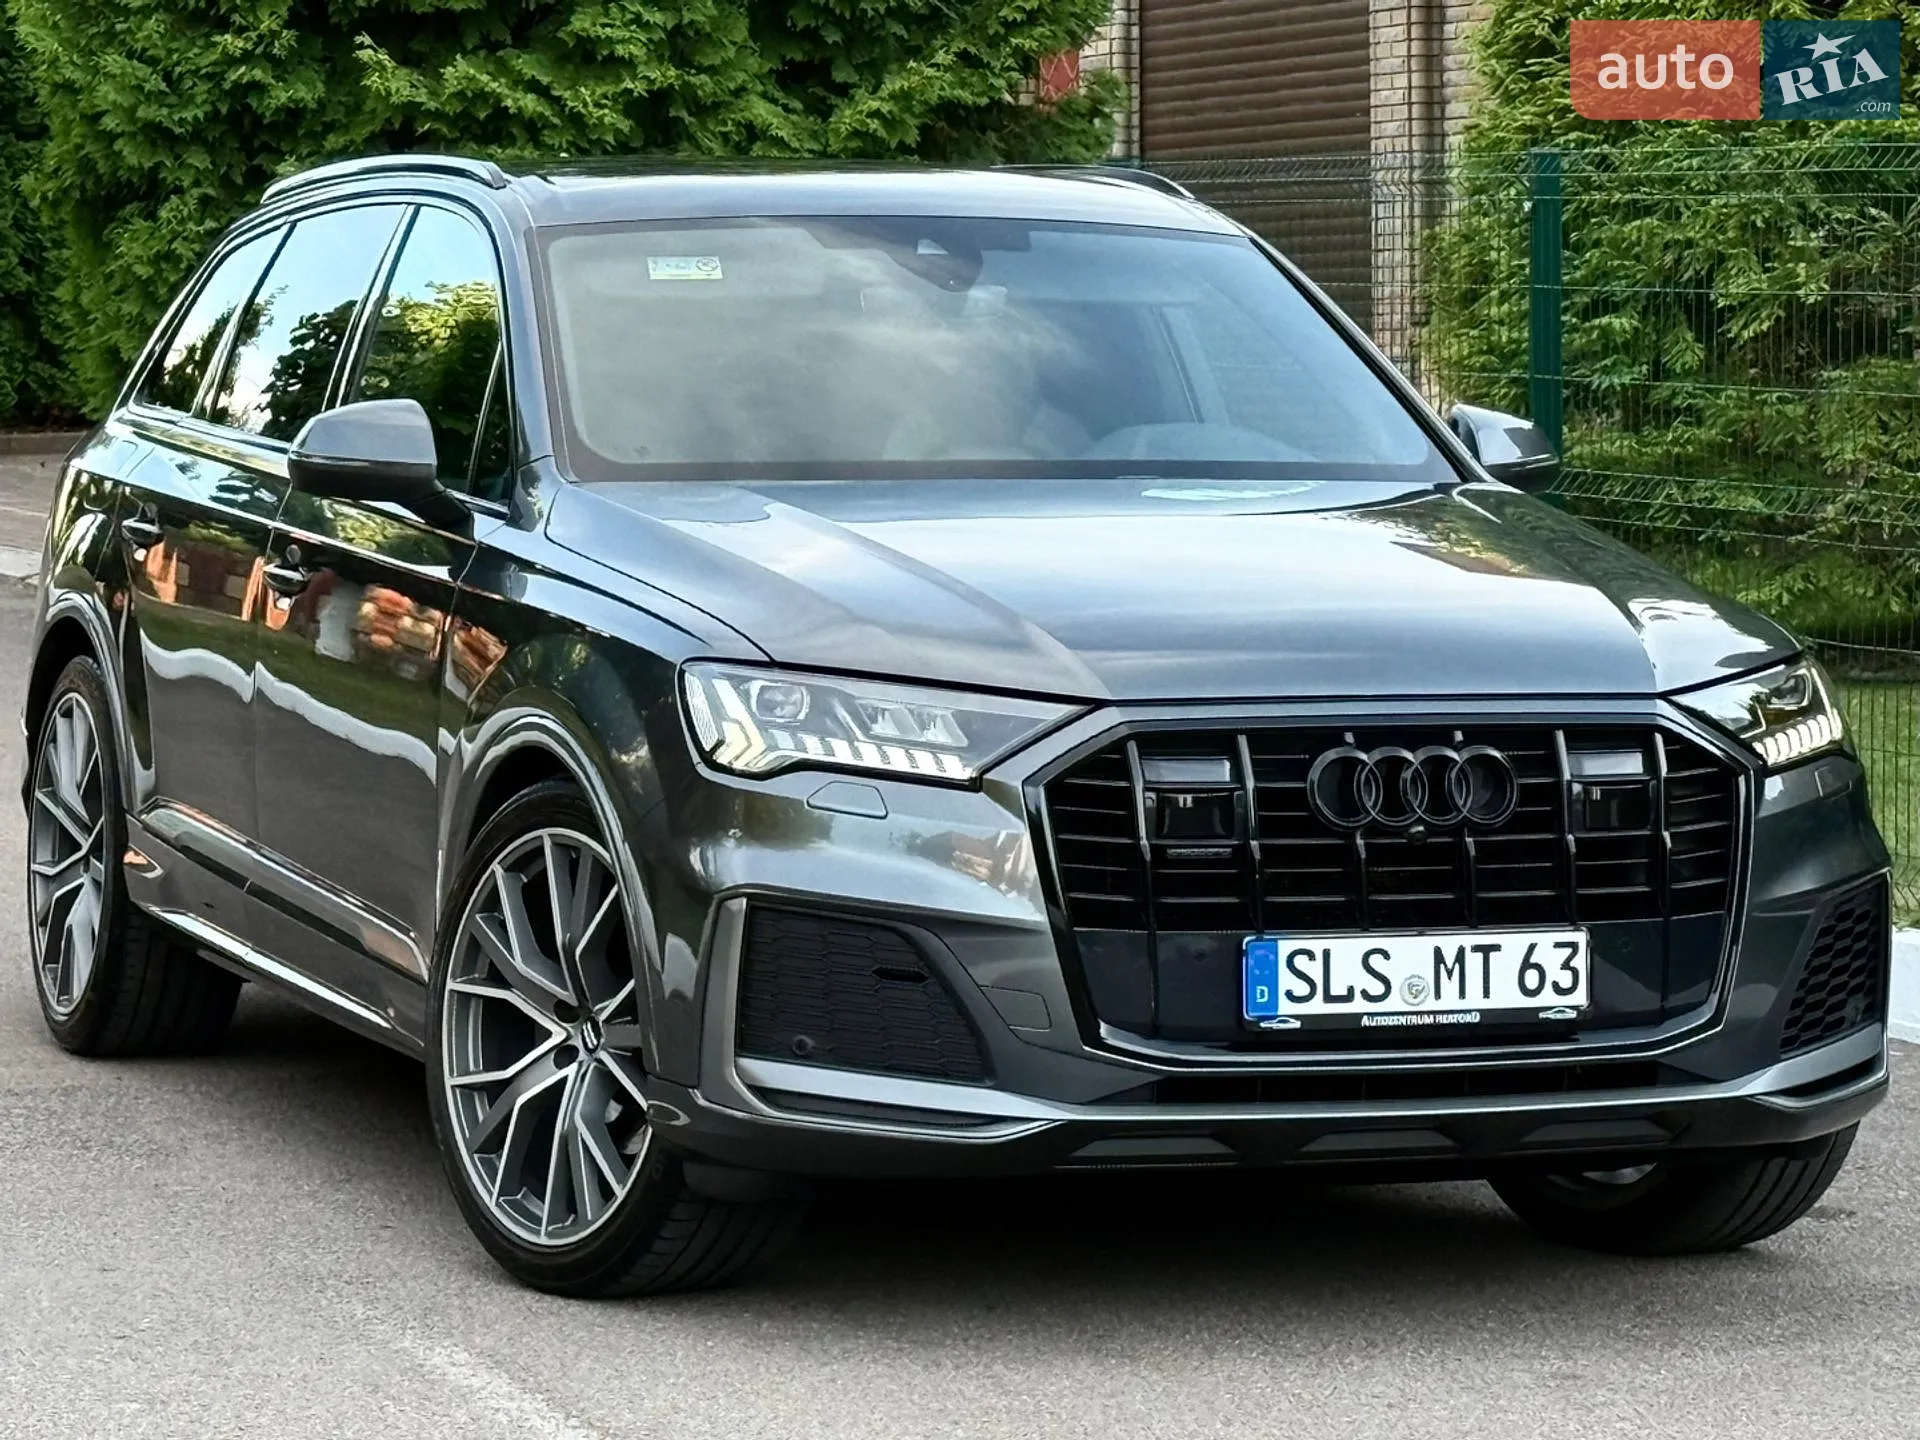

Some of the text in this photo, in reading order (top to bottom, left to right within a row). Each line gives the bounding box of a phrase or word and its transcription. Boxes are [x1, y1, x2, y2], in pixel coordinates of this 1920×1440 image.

[1284, 941, 1580, 1004] SLS MT 63
[1256, 986, 1269, 1003] D
